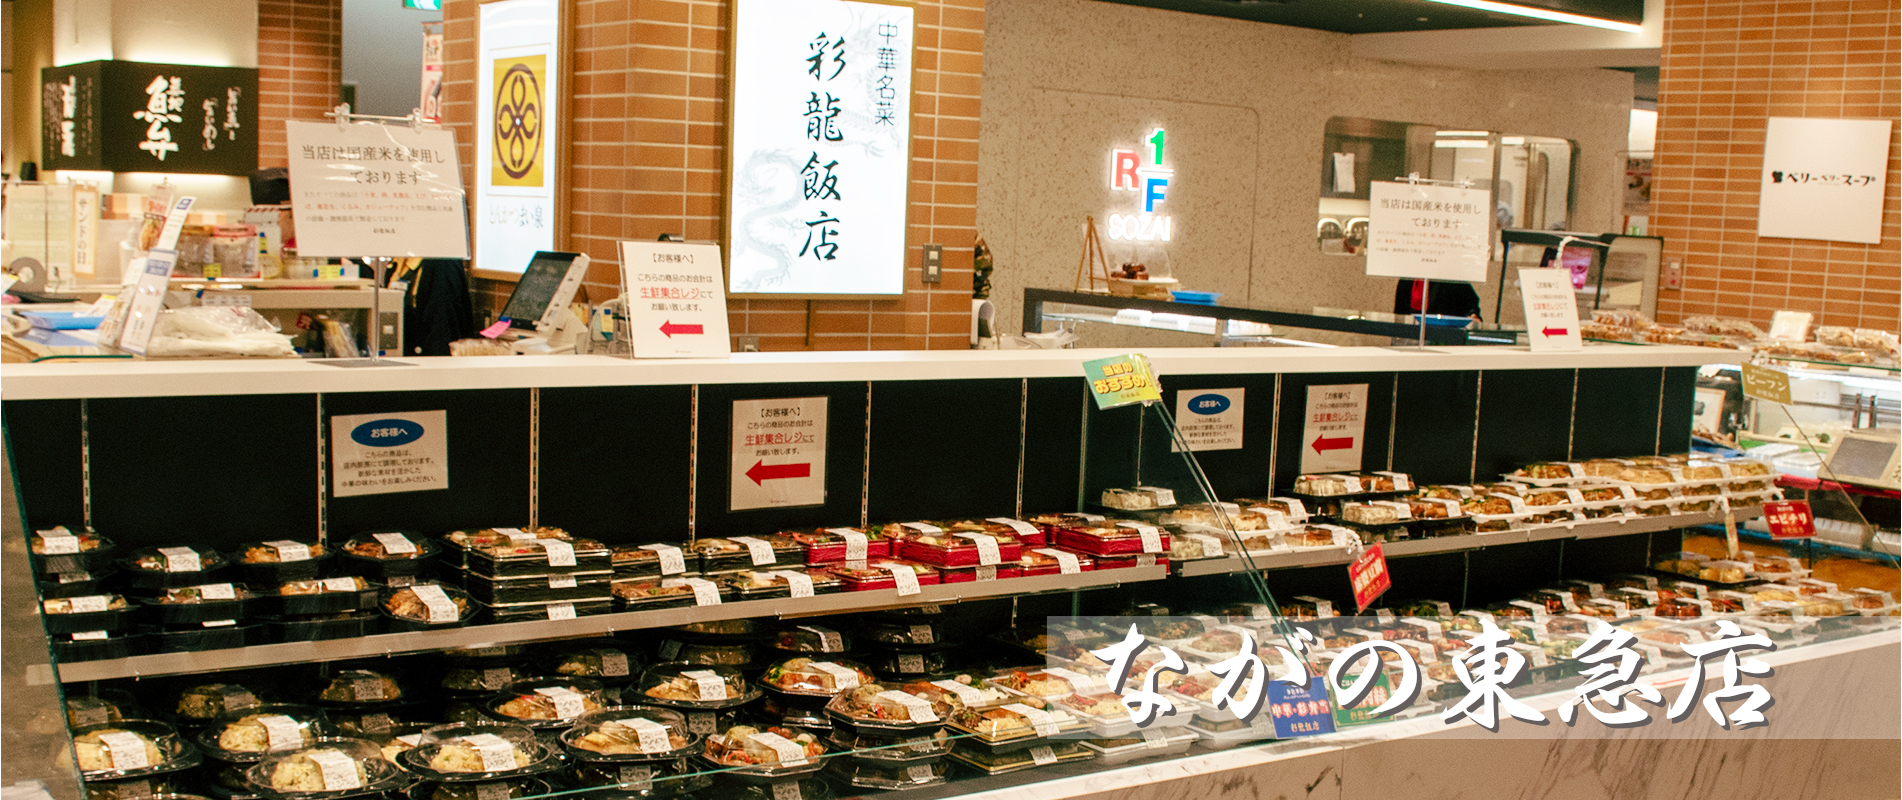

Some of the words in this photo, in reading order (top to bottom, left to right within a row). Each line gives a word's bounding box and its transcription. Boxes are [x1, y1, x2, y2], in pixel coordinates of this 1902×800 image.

[875, 20, 899, 127] 中華名菜
[799, 31, 847, 262] 彩龍飯店
[302, 145, 446, 164] 当店は国産米を使用し
[351, 170, 421, 186] ております
[1380, 198, 1481, 215] 当店は国産米を使用し
[1108, 213, 1171, 242] SOZAI
[1411, 217, 1462, 230] ております
[653, 253, 694, 264] 【お客様へ】
[638, 273, 713, 283] こちらの商品のお会計は
[640, 286, 713, 300] 生鮮集合レジにて
[1102, 362, 1133, 377] 当店の
[1746, 374, 1787, 392] ビーフン
[761, 407, 801, 418] 【お客様へ】
[370, 427, 408, 438] お客様へ
[747, 420, 813, 430] こちらの商品のお会計は
[745, 432, 815, 447] 生鮮集合レジにて
[1769, 512, 1808, 525] エビチリ
